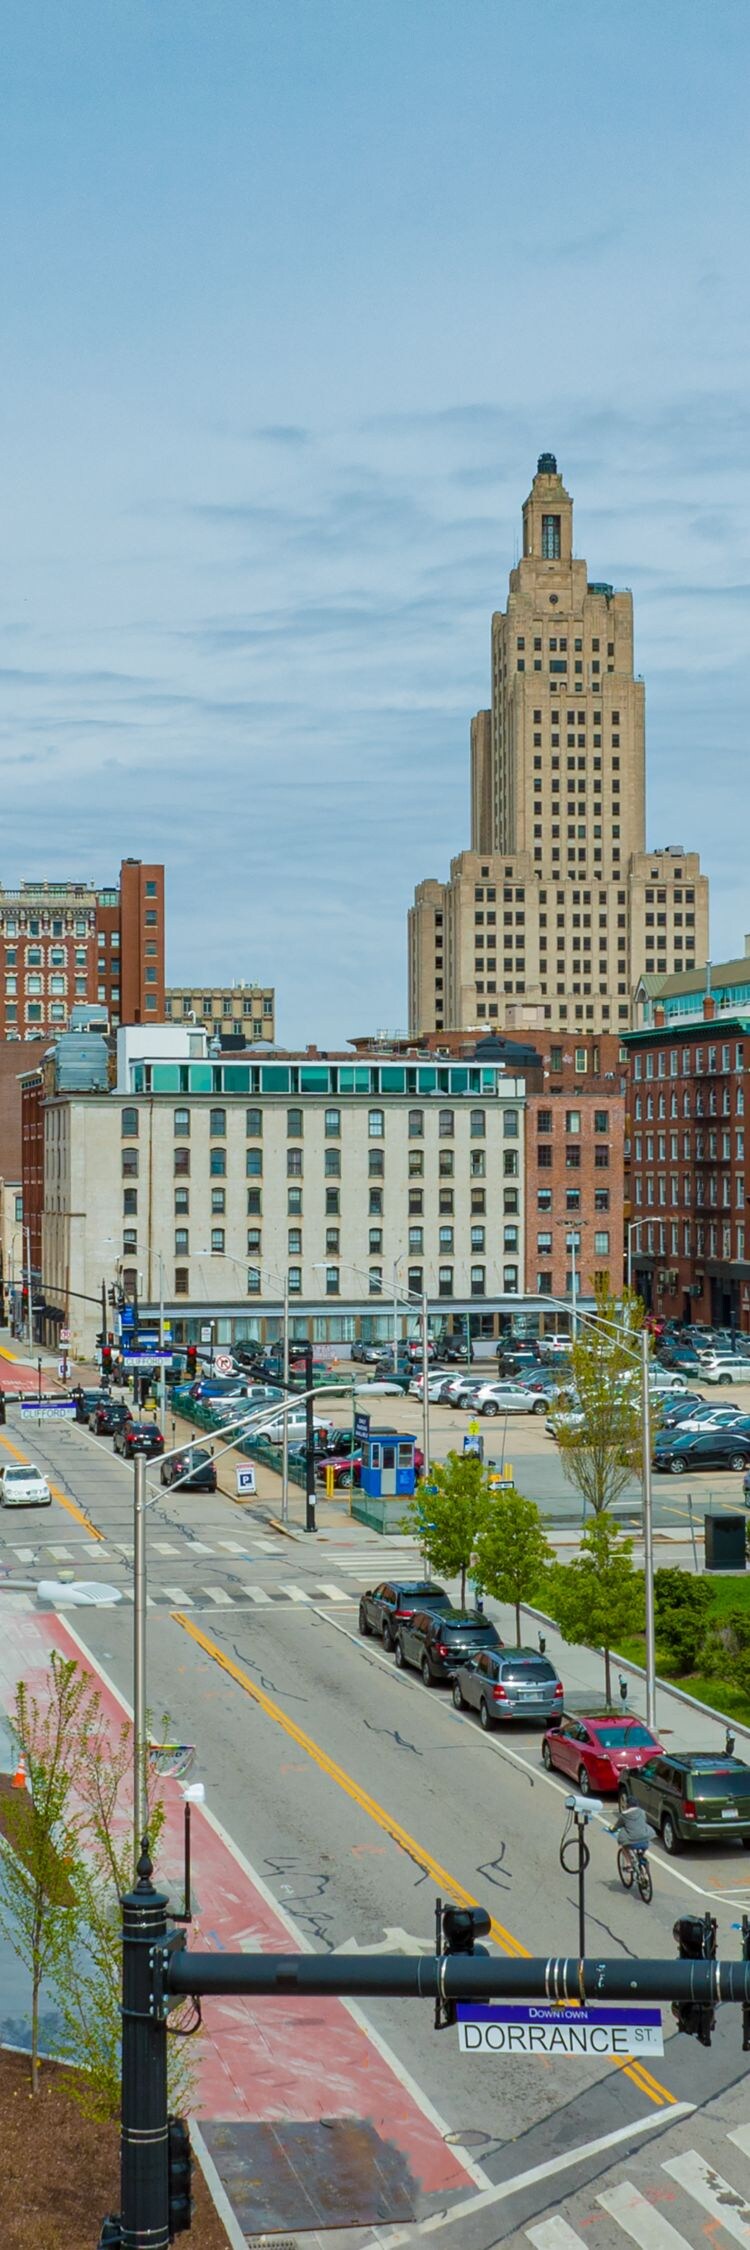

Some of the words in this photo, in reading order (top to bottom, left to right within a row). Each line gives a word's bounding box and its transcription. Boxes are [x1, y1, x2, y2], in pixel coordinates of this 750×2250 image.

[126, 1357, 164, 1365] CLIFFORD
[23, 1409, 66, 1418] CLIFFORD
[464, 2024, 629, 2053] DORRANCE
[634, 2028, 657, 2042] ST.
